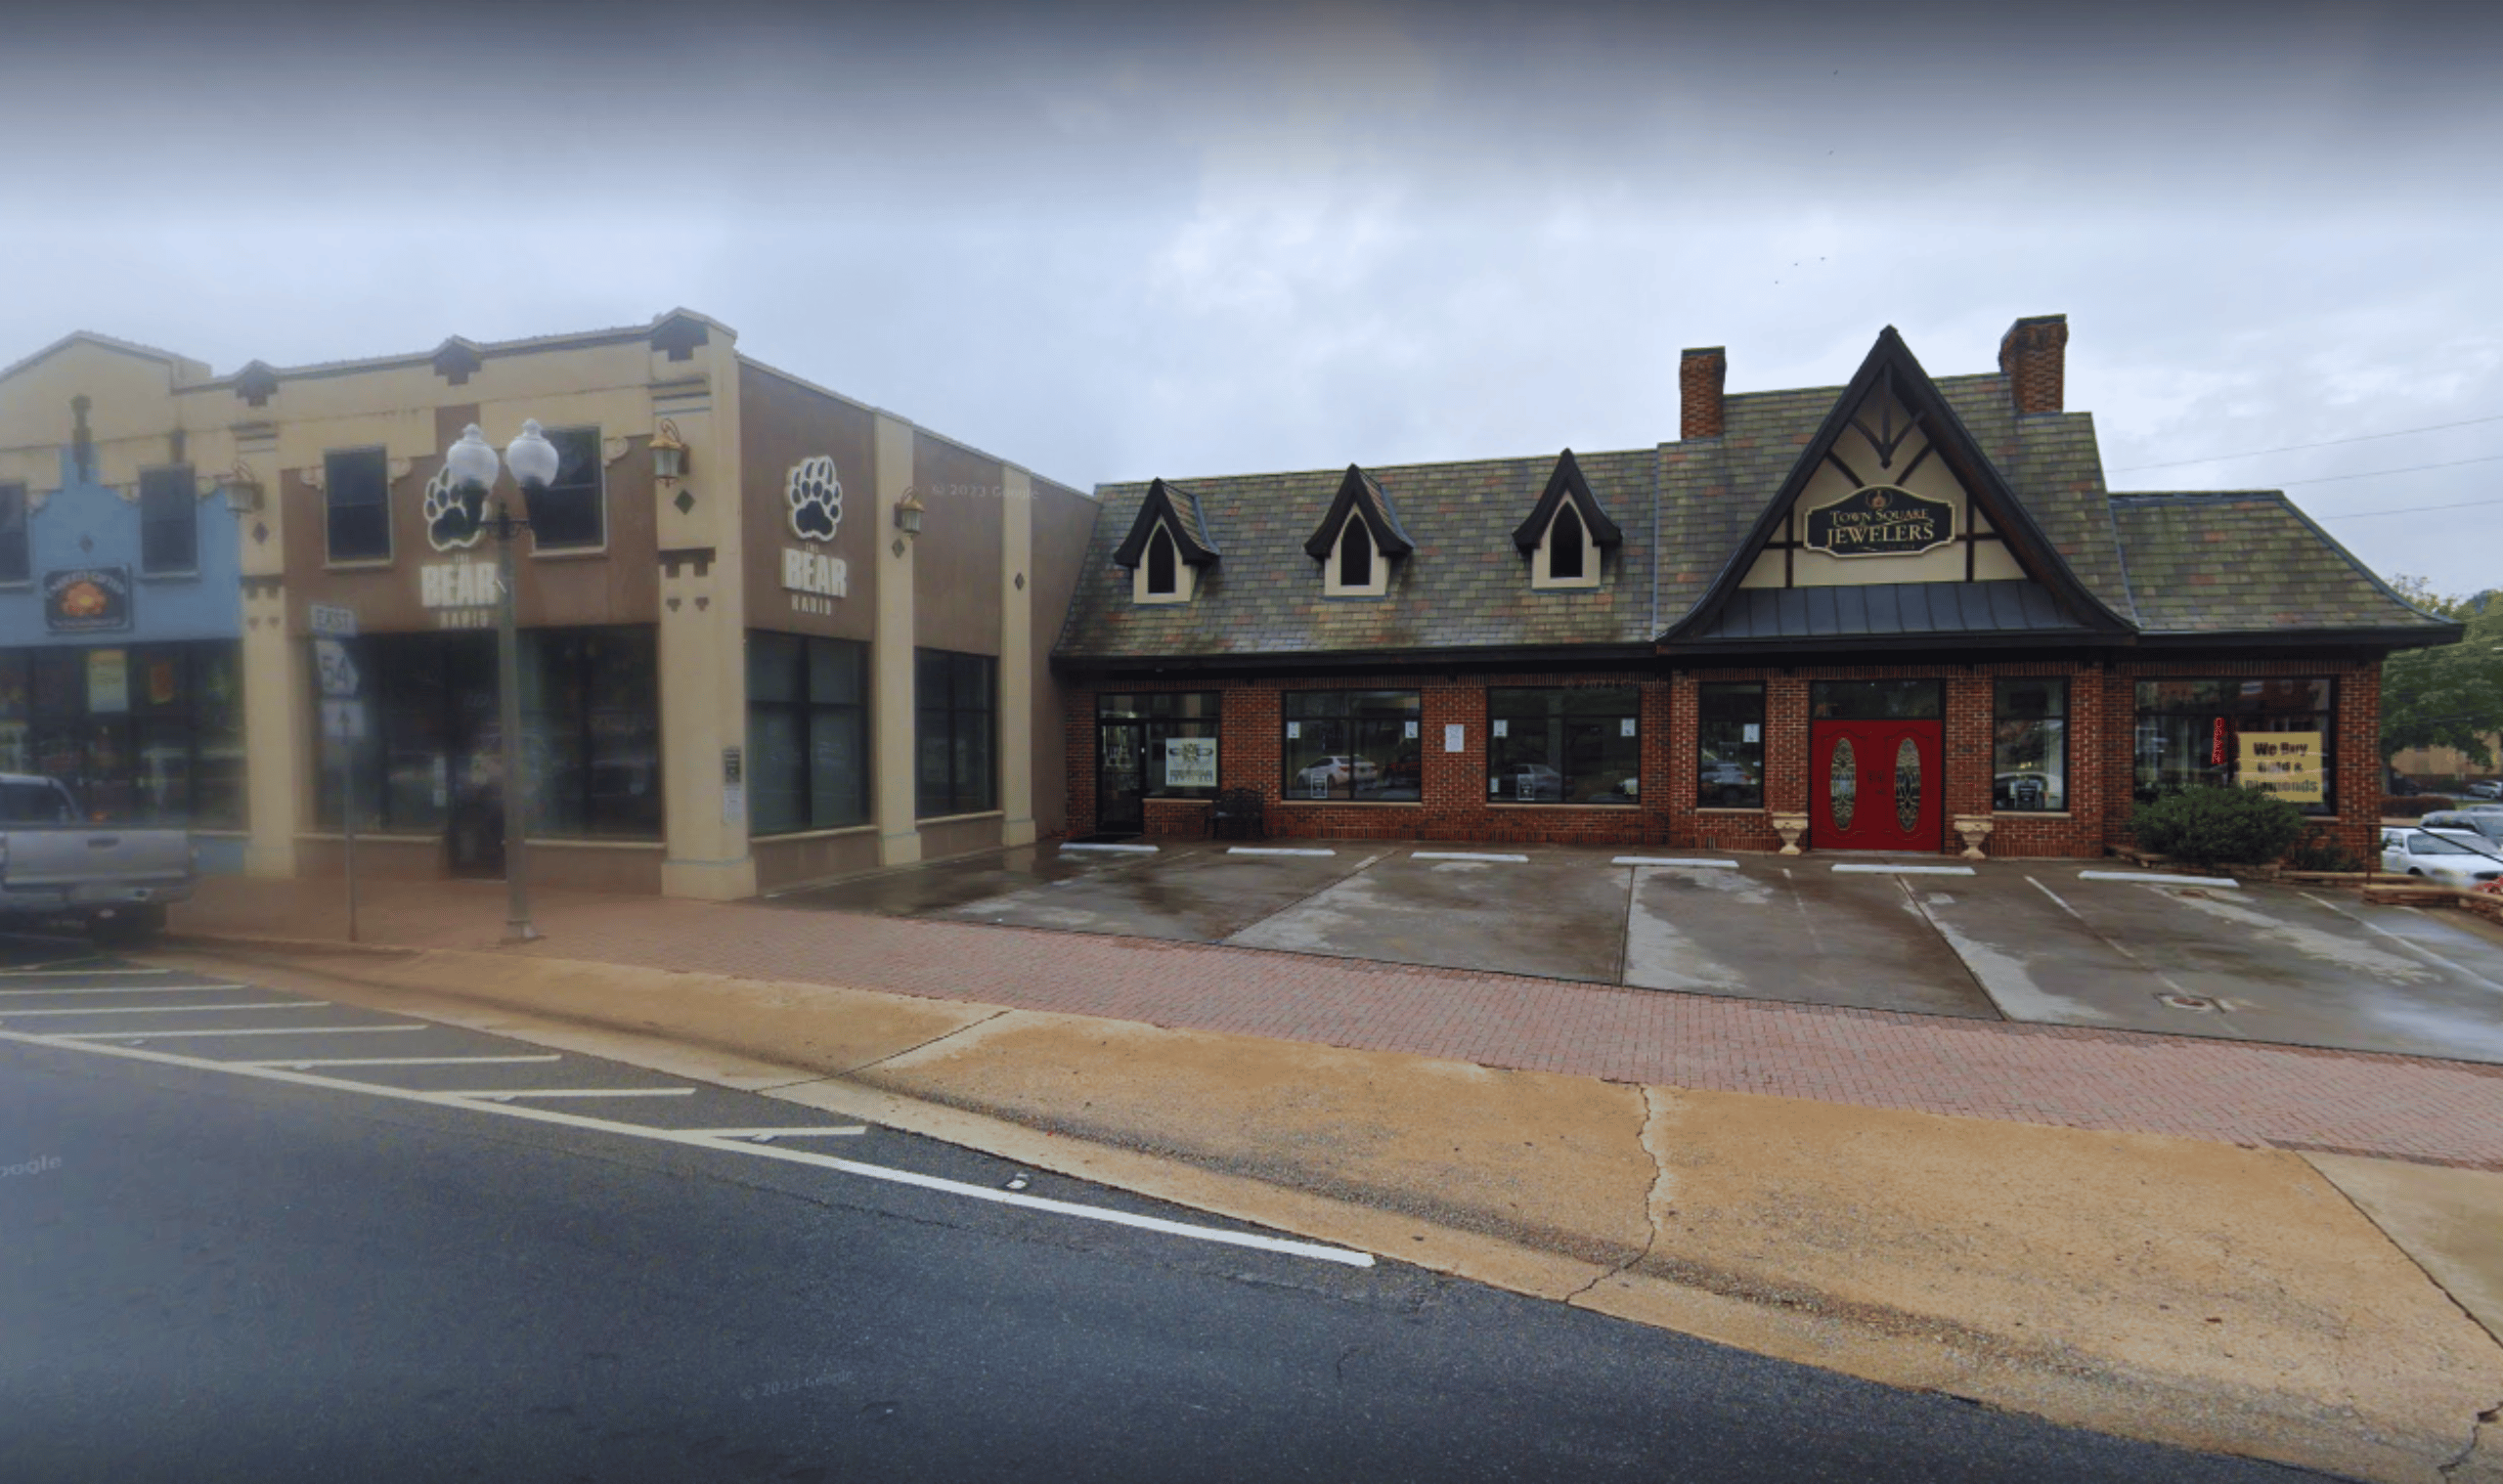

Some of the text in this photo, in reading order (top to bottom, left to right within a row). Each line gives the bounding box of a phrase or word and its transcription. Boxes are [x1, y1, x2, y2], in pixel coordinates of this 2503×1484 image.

[1827, 524, 1935, 548] JEWELERS
[783, 548, 847, 597] BEAR
[421, 563, 496, 607] BEAR
[792, 594, 831, 616] RADIO
[316, 608, 350, 629] EAST
[440, 611, 488, 628] RADIO
[322, 654, 350, 688] 54
[2254, 742, 2308, 757] We Buy
[2246, 779, 2319, 794] Diamonds
